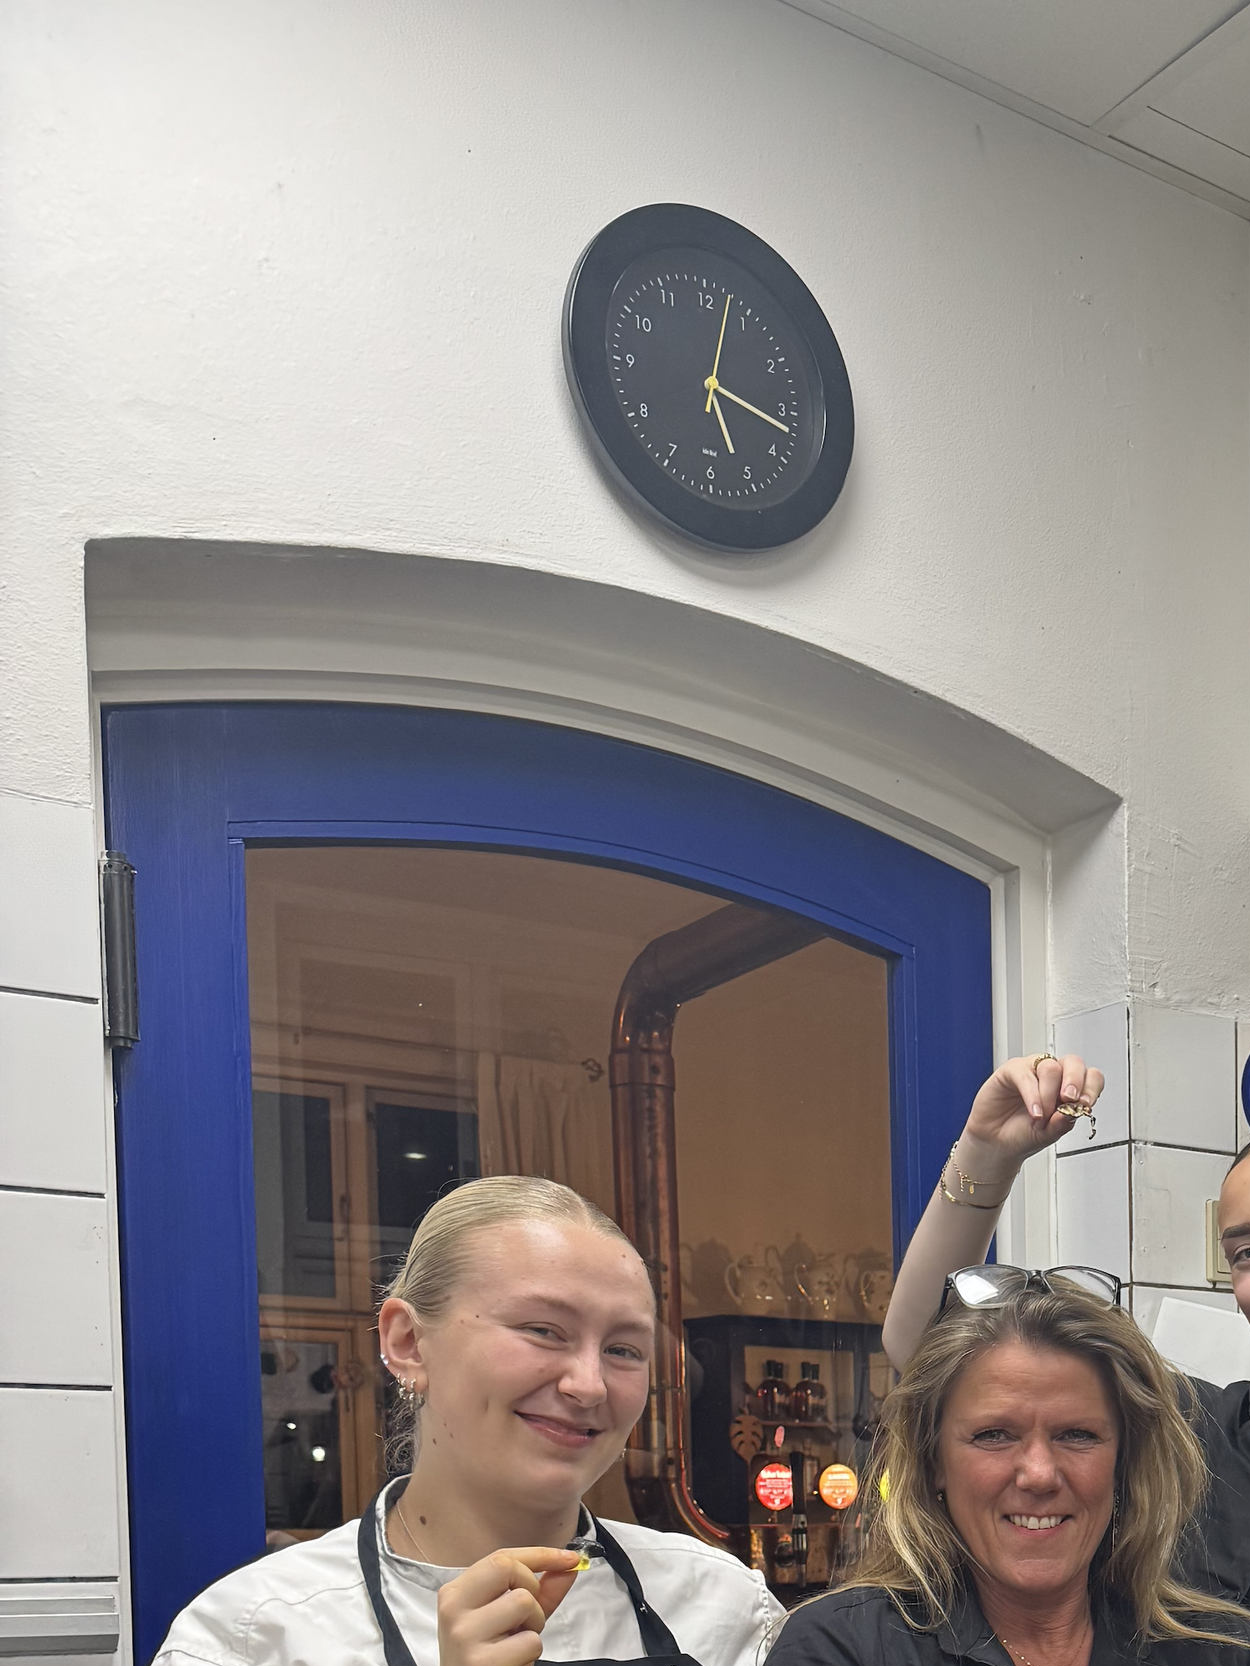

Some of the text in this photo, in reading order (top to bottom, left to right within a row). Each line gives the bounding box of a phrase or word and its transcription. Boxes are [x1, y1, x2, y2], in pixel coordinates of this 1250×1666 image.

[660, 288, 674, 307] 11
[698, 291, 714, 310] 12
[635, 314, 652, 333] 10
[740, 316, 745, 331] 1
[625, 353, 635, 368] 9
[766, 358, 775, 374] 2
[639, 402, 649, 418] 8
[778, 402, 786, 417] 3
[668, 442, 678, 457] 7
[768, 443, 777, 457] 4
[706, 465, 715, 480] 6
[742, 465, 752, 480] 5
